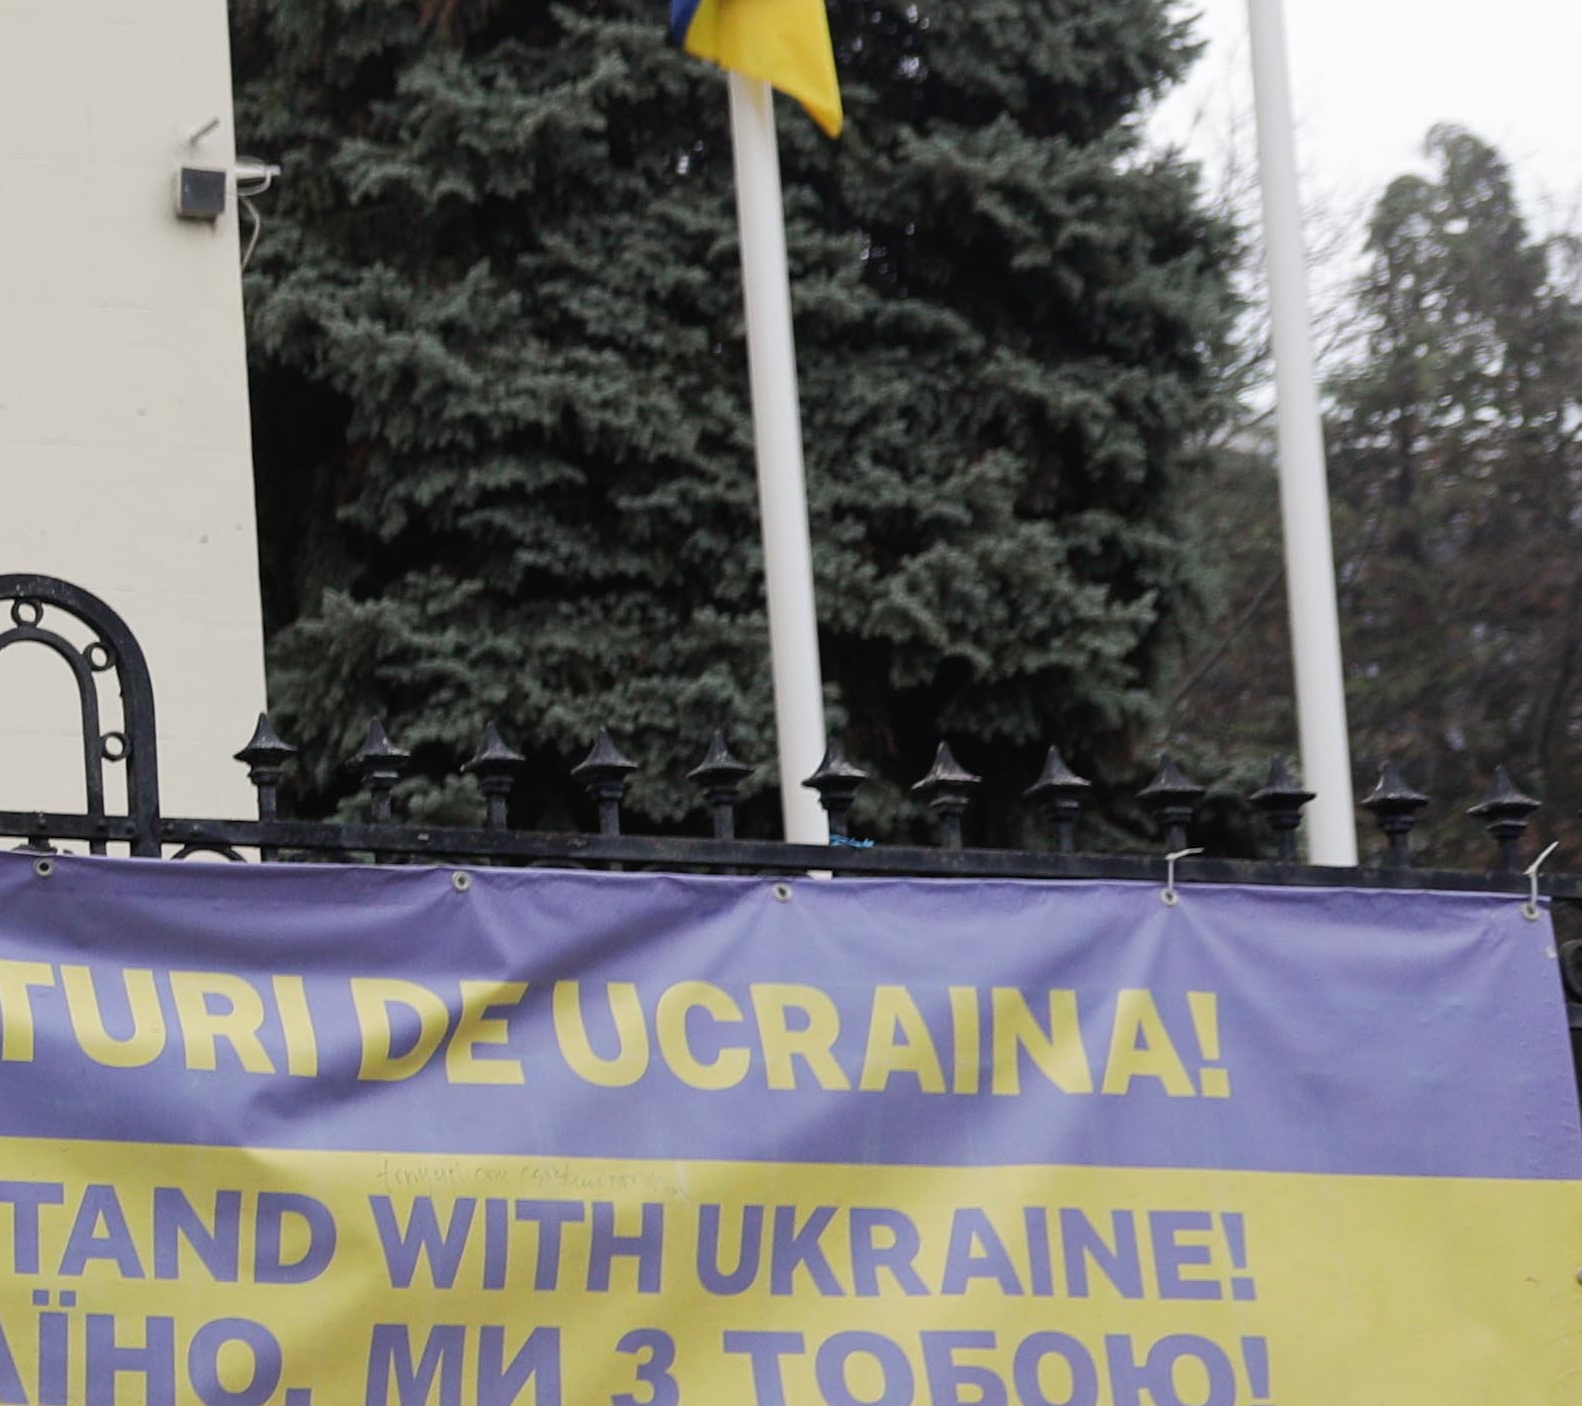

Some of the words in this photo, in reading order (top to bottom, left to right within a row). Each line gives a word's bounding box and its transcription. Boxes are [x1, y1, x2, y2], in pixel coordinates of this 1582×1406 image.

[355, 975, 527, 1086] DE
[552, 980, 1231, 1101] UCRAINA!
[369, 1193, 664, 1295] WITH
[696, 1204, 1258, 1302] UKRAINE!
